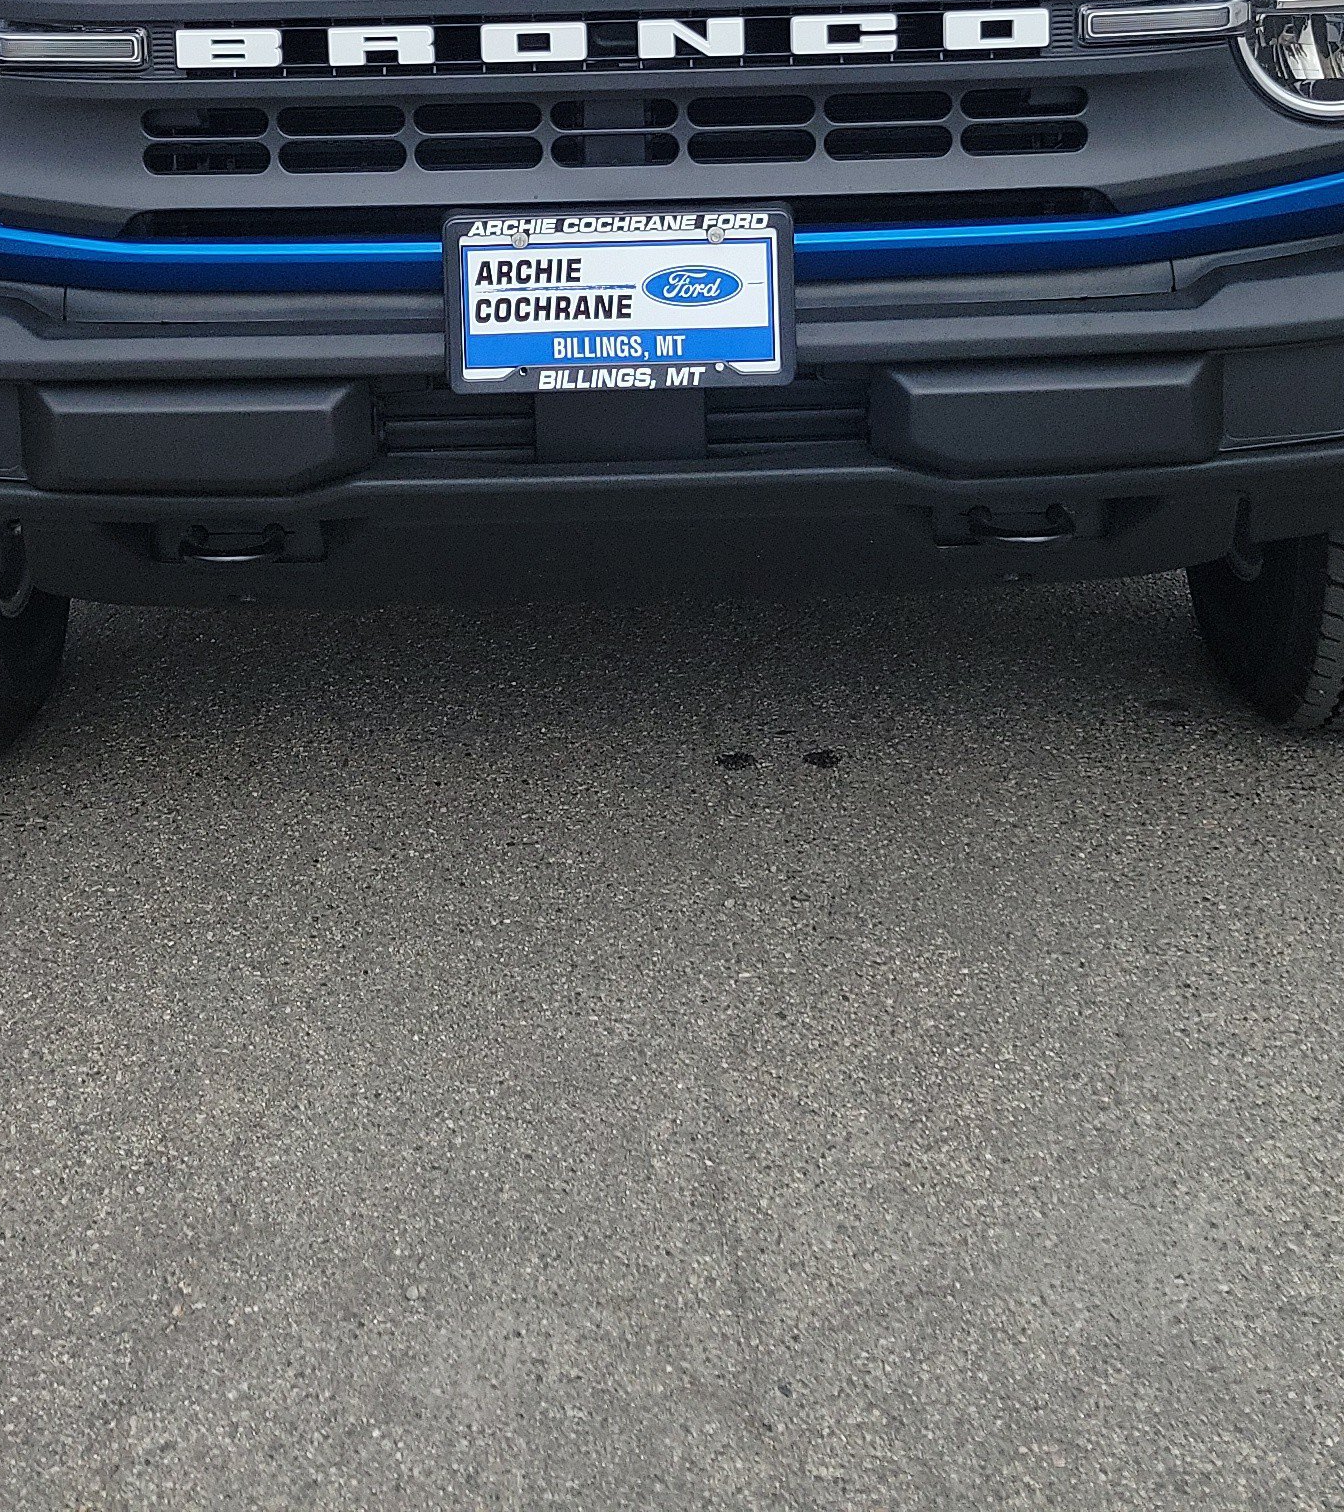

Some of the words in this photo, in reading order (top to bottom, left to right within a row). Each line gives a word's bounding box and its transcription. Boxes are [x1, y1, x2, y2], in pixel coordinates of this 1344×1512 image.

[174, 6, 1052, 70] BRONCO
[467, 219, 556, 237] ARCHIE
[562, 214, 696, 233] COCHRANE
[702, 213, 769, 231] FORD
[475, 257, 582, 286] ARCHIE
[662, 271, 721, 299] Ford
[474, 294, 633, 324] COCHRANE
[552, 335, 650, 360] BILLINGS,
[656, 335, 686, 357] MT
[538, 368, 657, 390] BILLINGS,
[665, 366, 707, 386] MT
